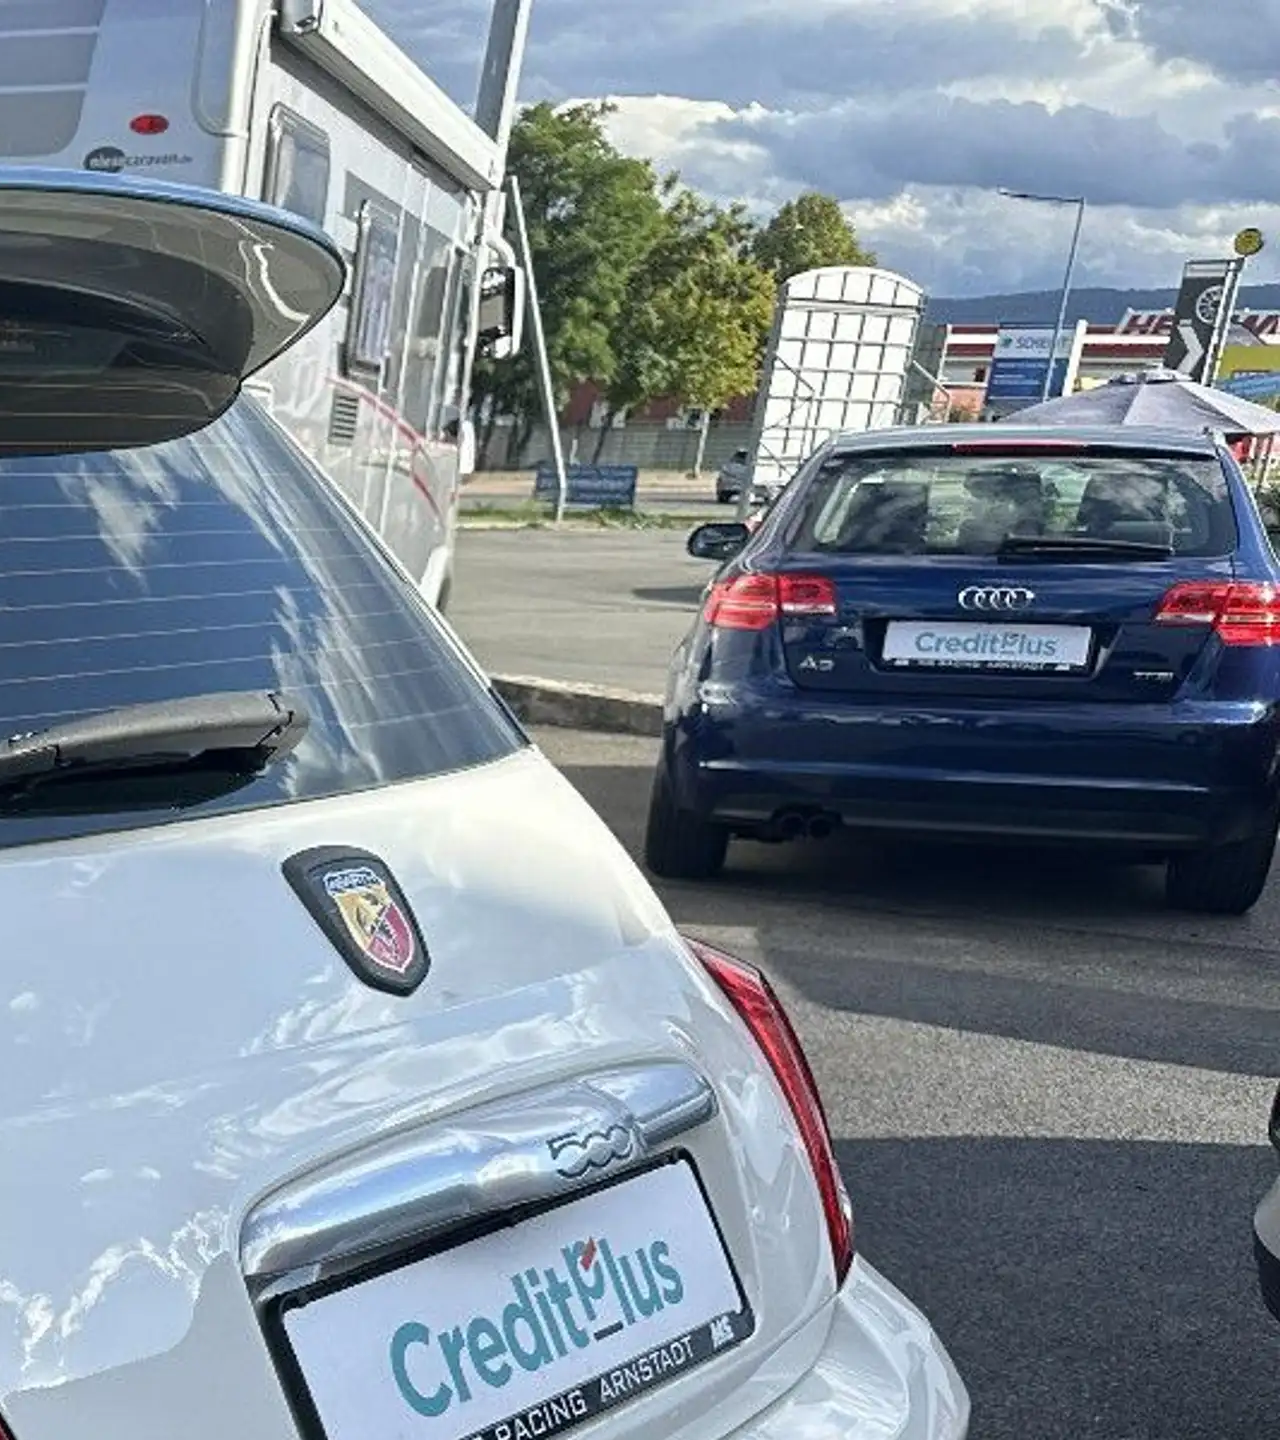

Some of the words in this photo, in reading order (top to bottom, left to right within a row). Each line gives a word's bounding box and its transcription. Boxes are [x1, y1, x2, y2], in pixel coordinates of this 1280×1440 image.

[914, 631, 1060, 656] CreditPlus
[545, 1123, 634, 1178] 500
[389, 1237, 684, 1418] CreditPlus
[598, 1337, 696, 1403] ARNSTADT
